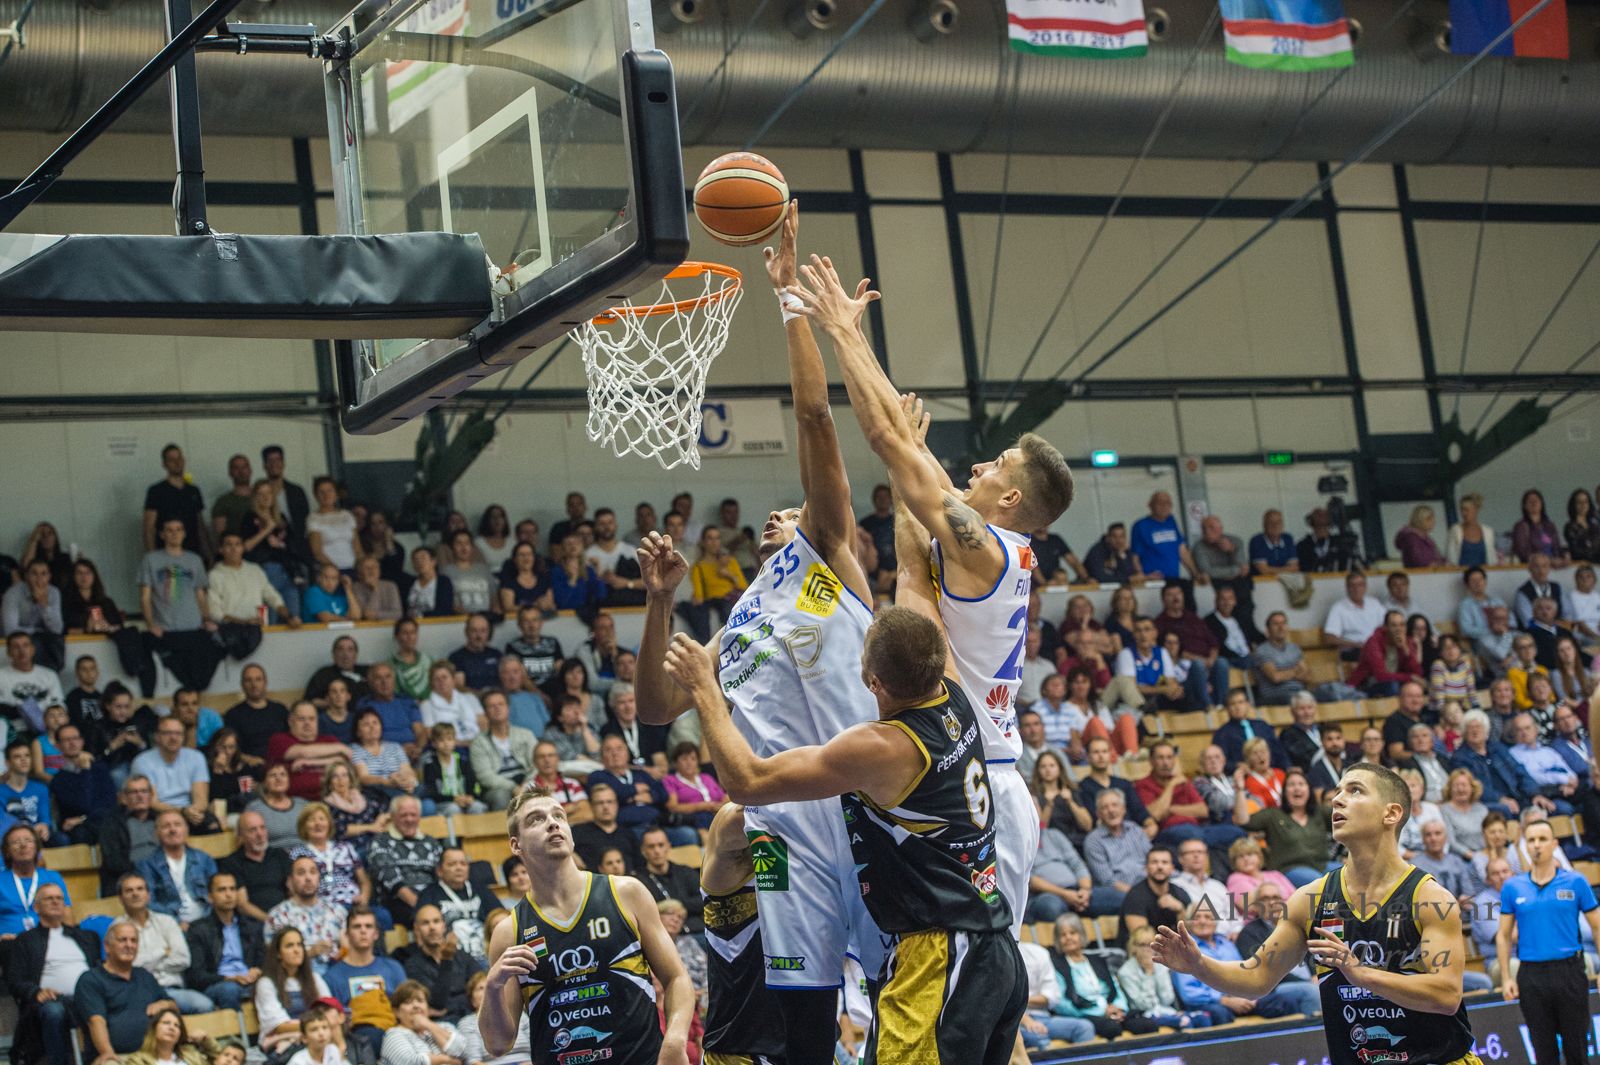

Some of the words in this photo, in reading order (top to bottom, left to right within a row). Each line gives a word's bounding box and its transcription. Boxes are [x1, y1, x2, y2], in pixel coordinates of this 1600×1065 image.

[964, 757, 990, 830] 6
[587, 917, 610, 940] 10
[548, 945, 595, 976] 100
[564, 1005, 611, 1021] VEOLIA
[1358, 1007, 1406, 1019] VEOLIA
